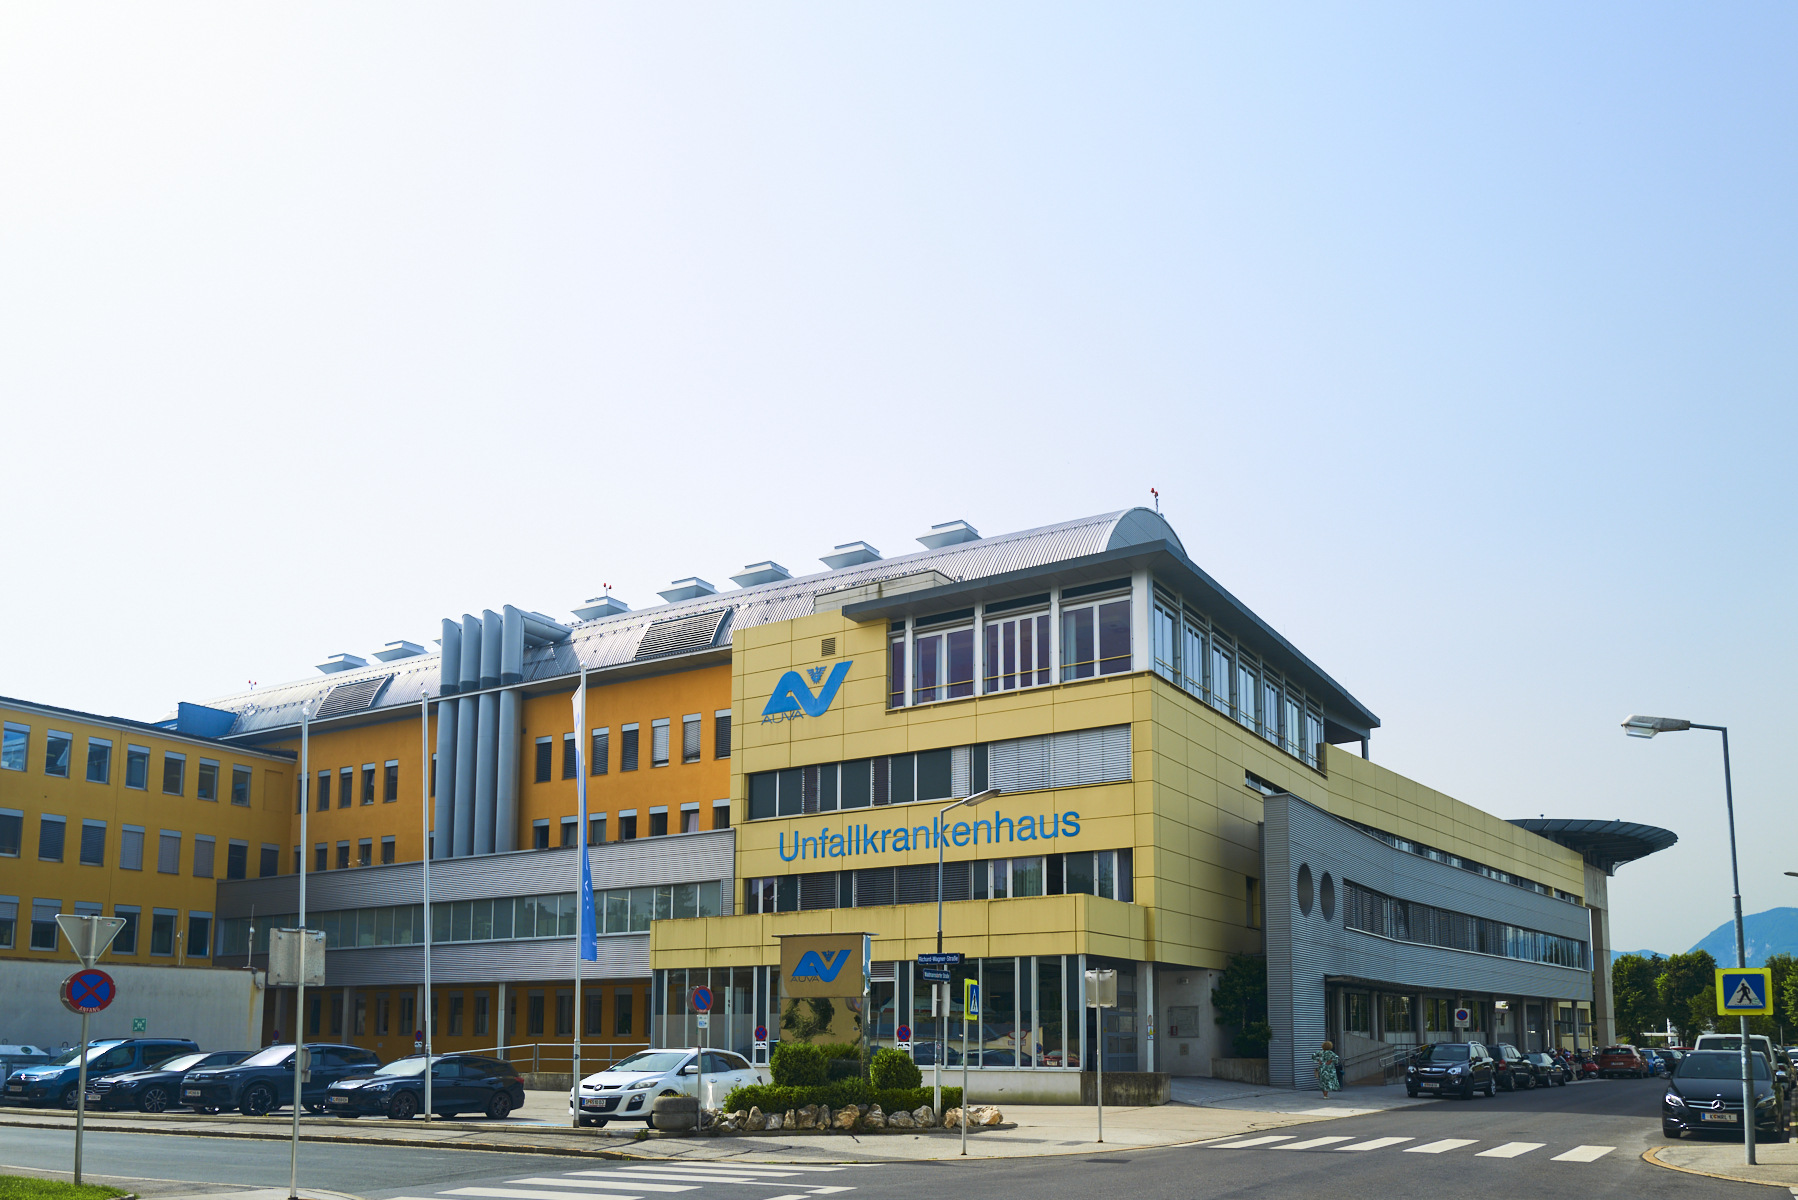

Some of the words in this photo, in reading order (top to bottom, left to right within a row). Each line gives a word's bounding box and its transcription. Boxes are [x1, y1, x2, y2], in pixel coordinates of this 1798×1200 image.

[761, 710, 804, 726] AUVA
[779, 810, 1081, 862] Unfallkrankenhaus
[790, 975, 820, 983] AUVA
